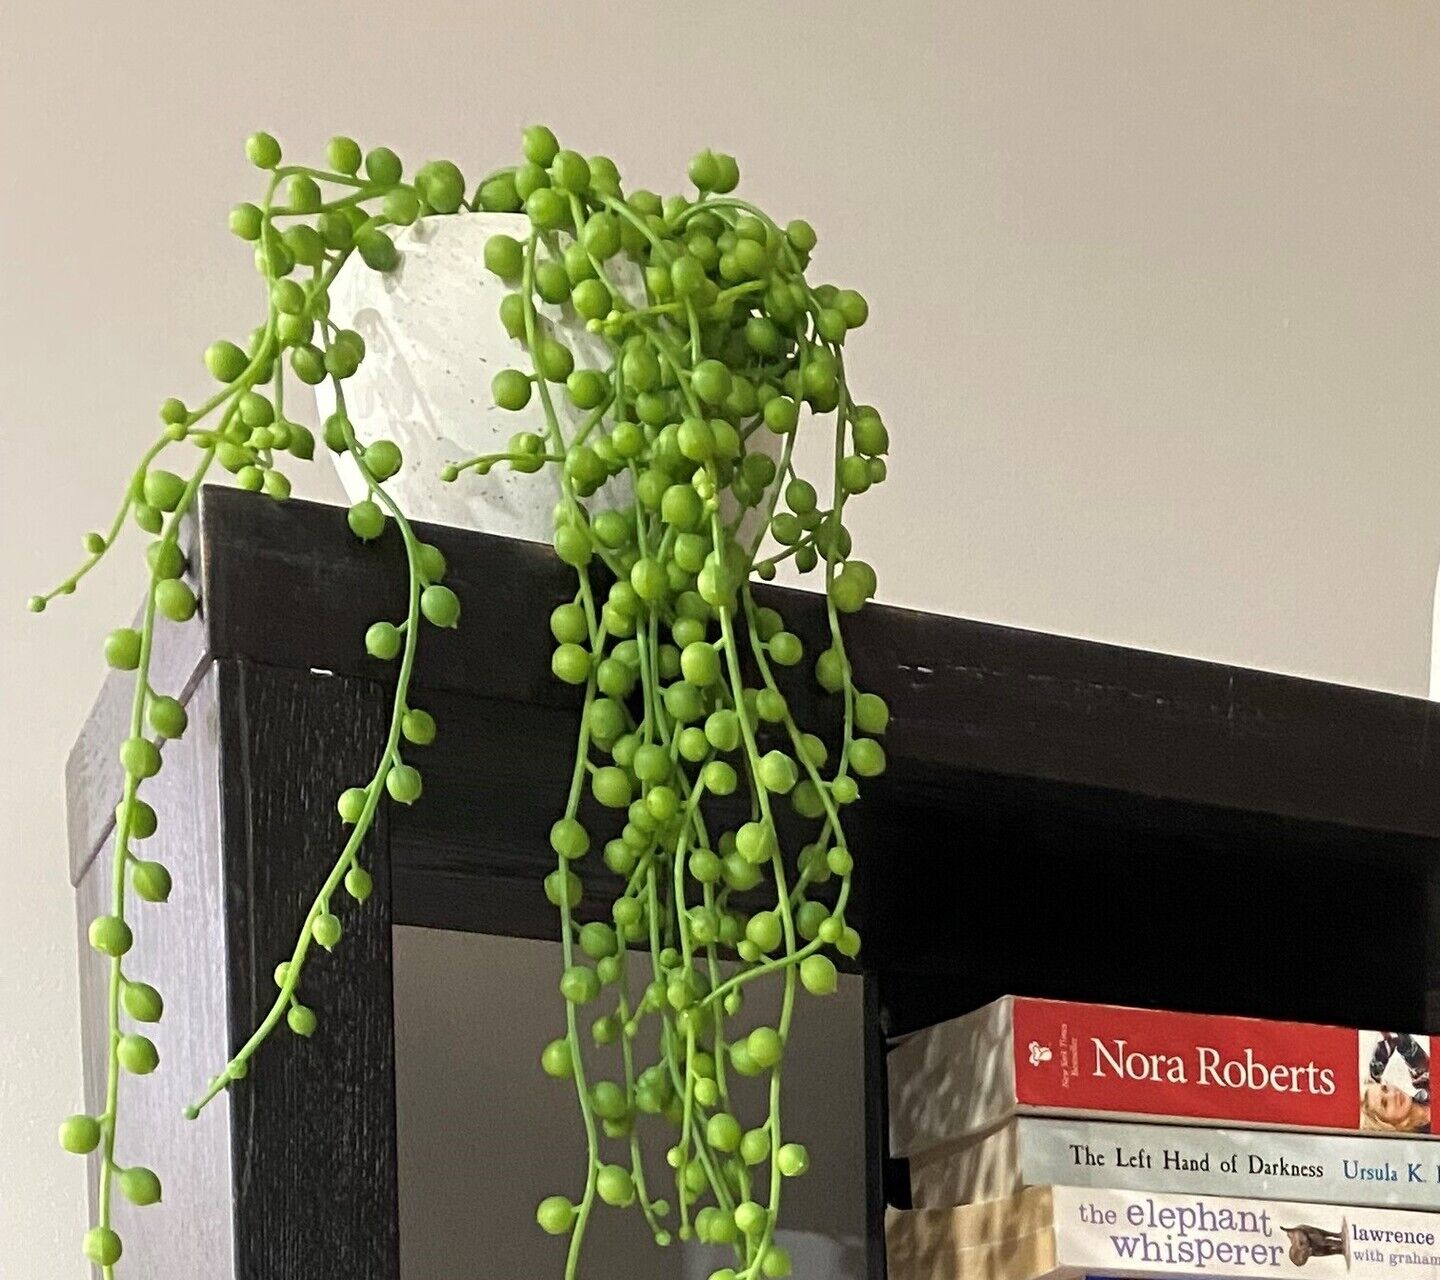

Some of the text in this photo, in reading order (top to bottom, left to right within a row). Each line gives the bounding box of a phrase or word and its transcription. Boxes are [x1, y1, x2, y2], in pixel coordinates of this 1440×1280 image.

[1091, 1037, 1187, 1084] Nora
[1197, 1046, 1335, 1096] Roberts
[1069, 1143, 1325, 1178] The Left Hand of Darkness
[1342, 1159, 1399, 1182] Ursula
[1079, 1199, 1272, 1238] the elephant
[1109, 1230, 1284, 1268] whisperer
[1352, 1224, 1434, 1249] lawrence
[1353, 1246, 1384, 1265] with
